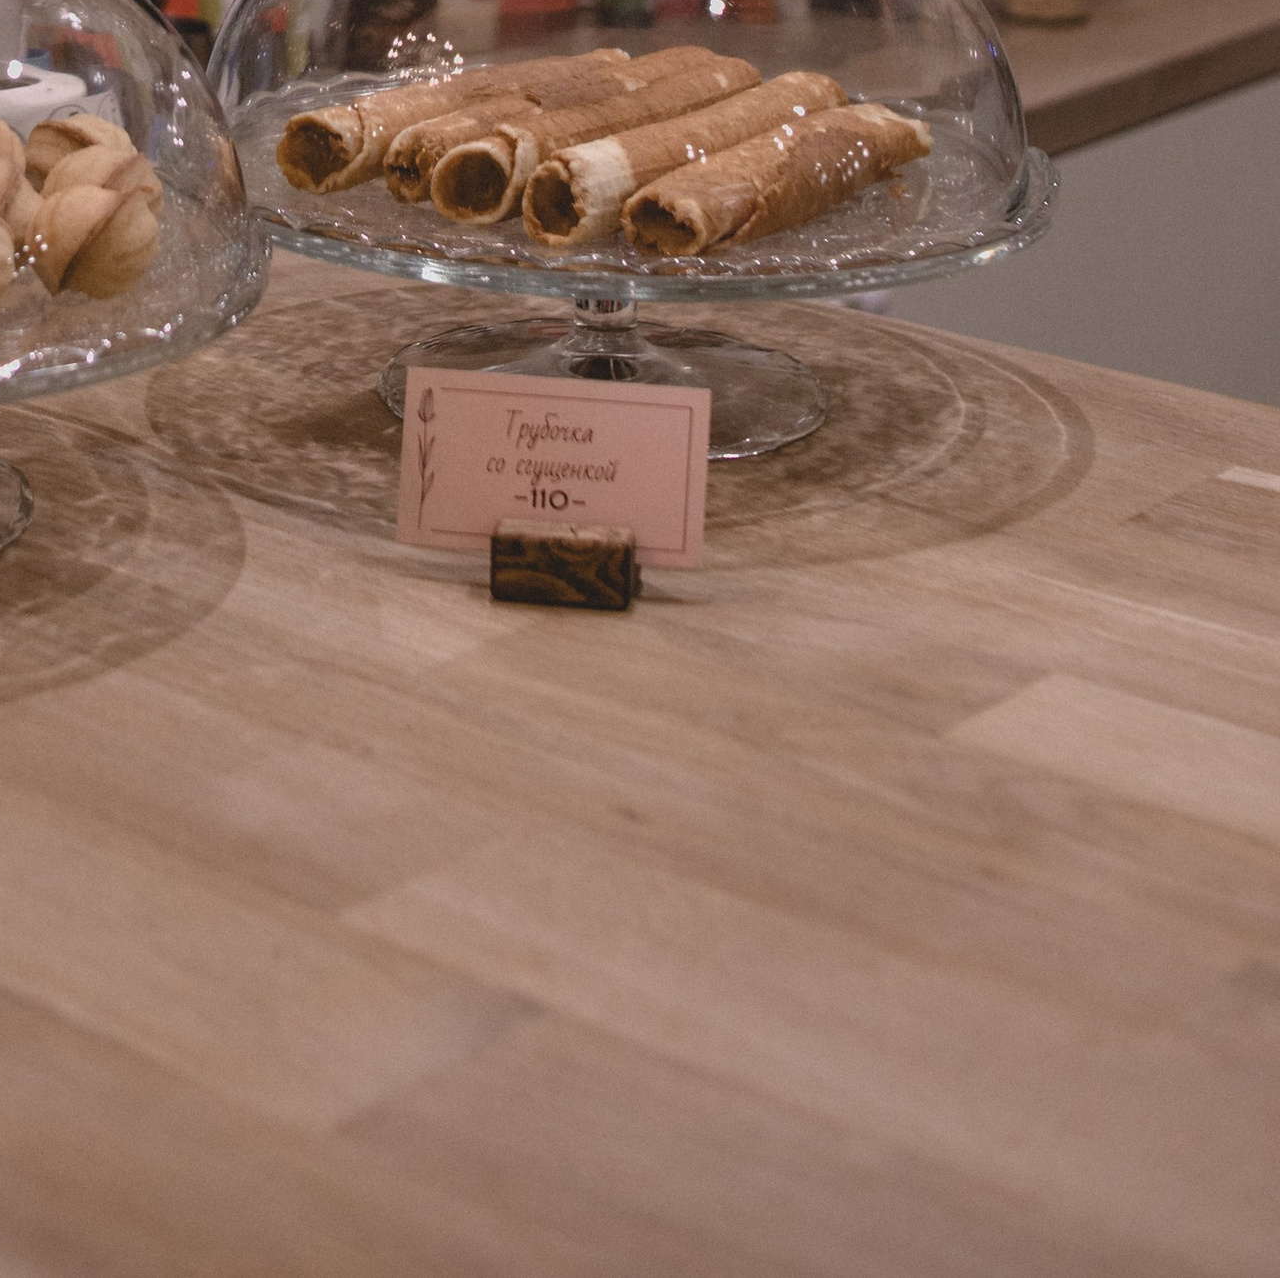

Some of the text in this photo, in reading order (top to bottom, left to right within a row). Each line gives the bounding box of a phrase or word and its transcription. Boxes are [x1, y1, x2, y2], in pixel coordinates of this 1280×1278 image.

[505, 408, 595, 451] Трубочка
[486, 456, 618, 485] со сгущенкой
